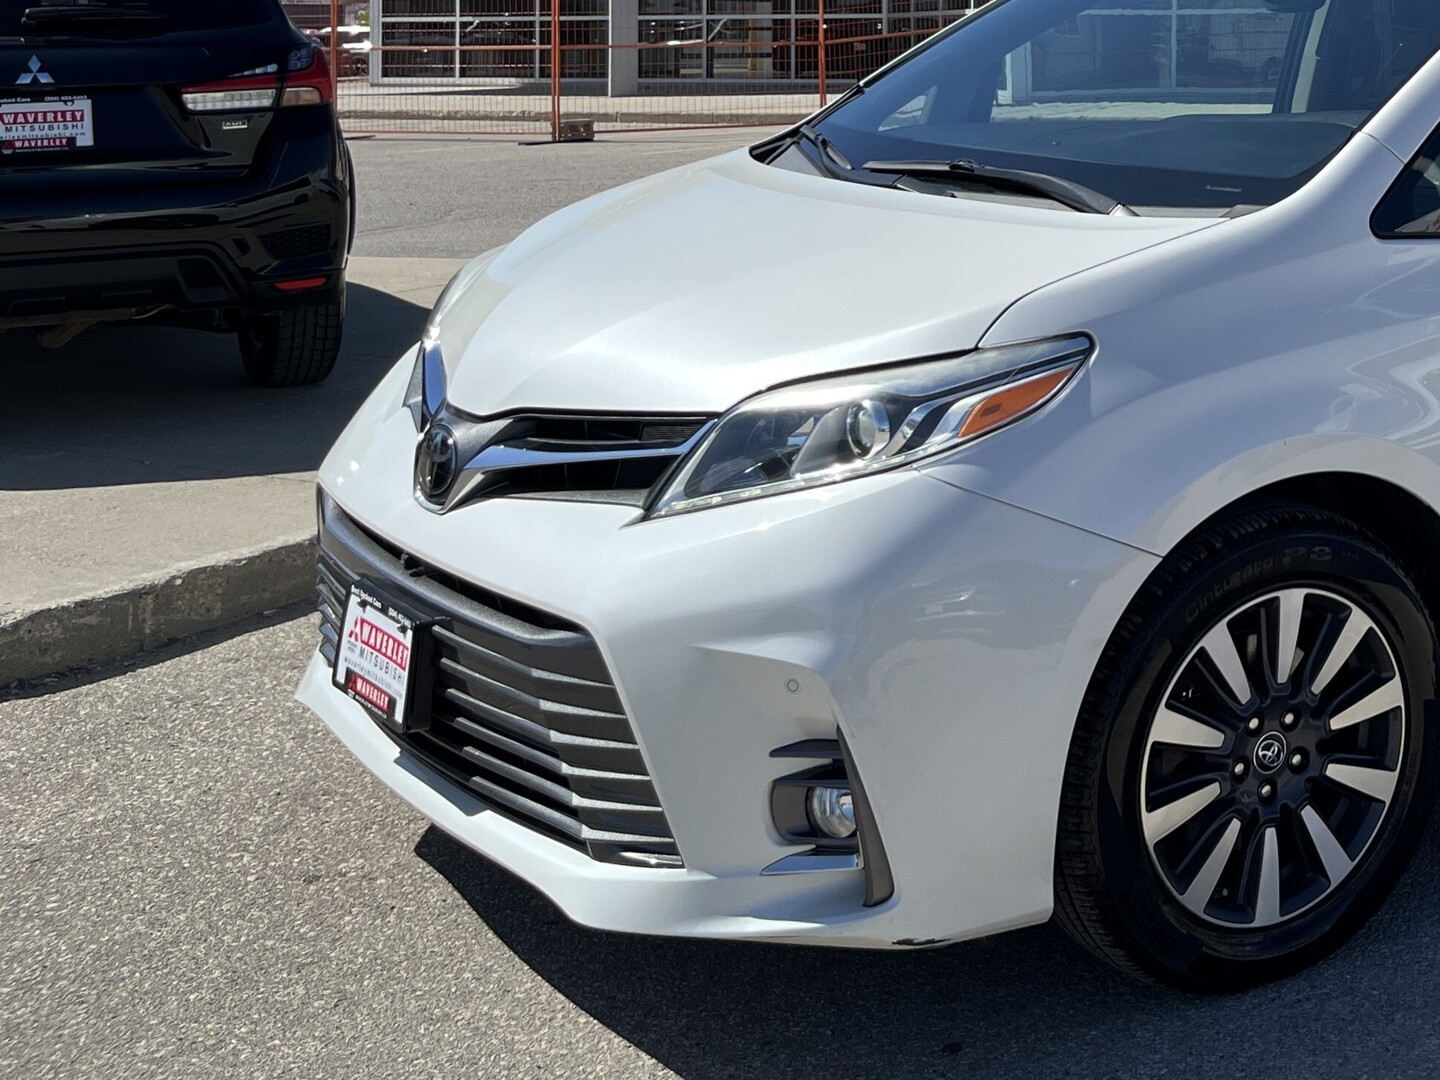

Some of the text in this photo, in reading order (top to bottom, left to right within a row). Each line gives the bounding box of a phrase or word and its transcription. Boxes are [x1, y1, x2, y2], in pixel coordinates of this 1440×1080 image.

[3, 111, 82, 124] WAVERLEY
[5, 123, 84, 133] MITSUBISHI
[15, 138, 68, 148] WAVERLEY
[362, 622, 409, 668] WAVERLEY
[359, 645, 405, 686] MITSUBISHI
[356, 677, 389, 709] WAVERLEY
